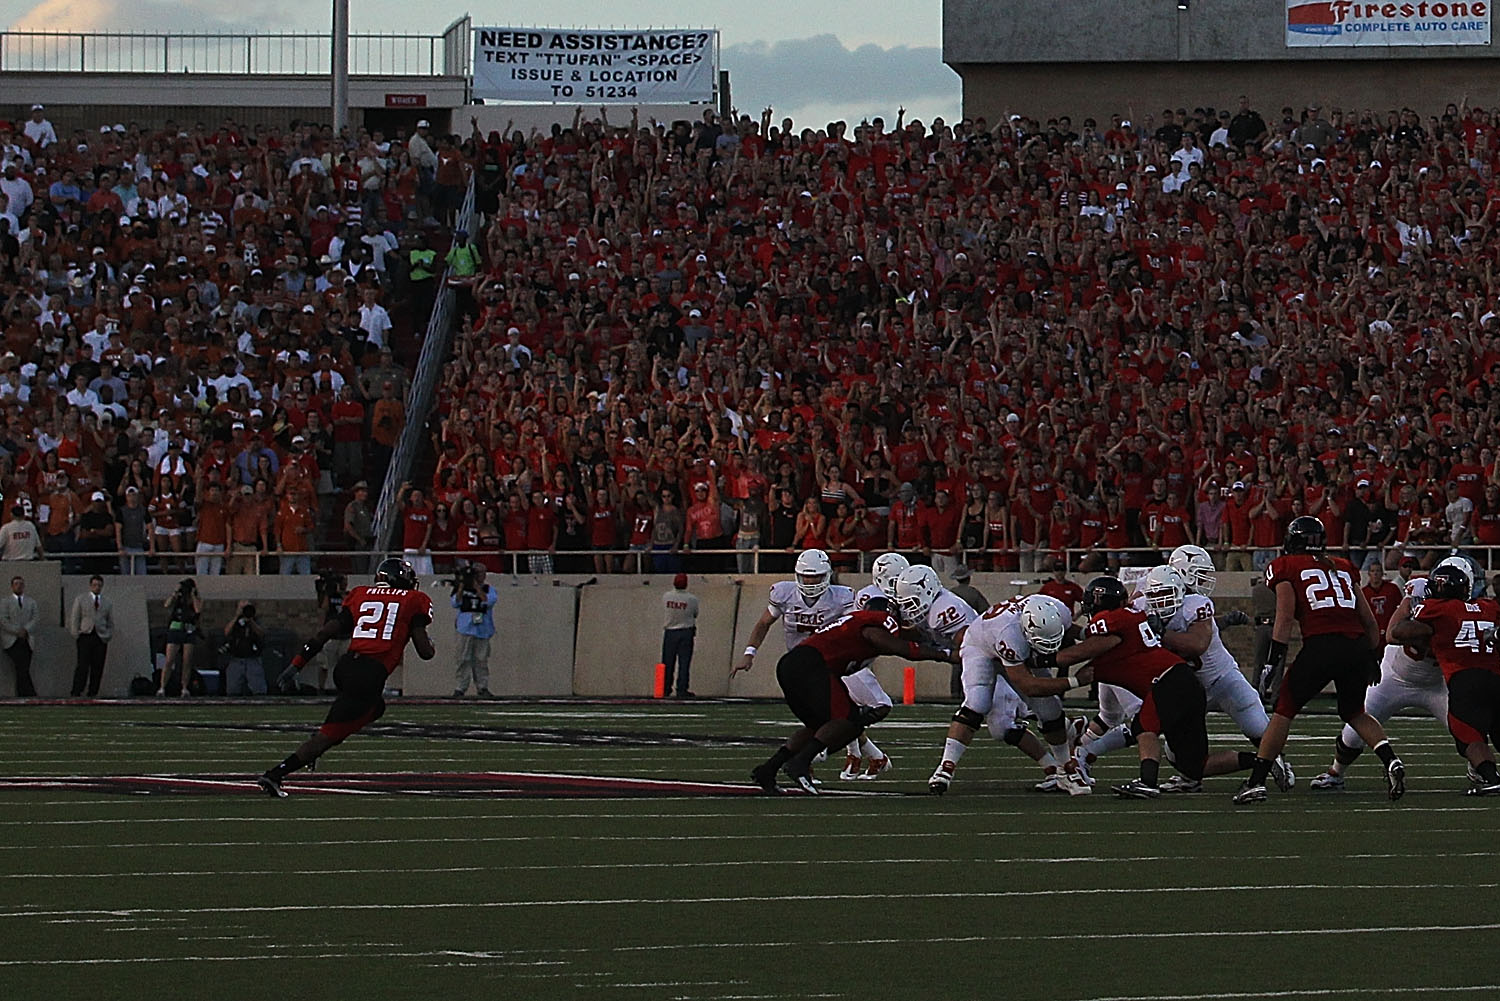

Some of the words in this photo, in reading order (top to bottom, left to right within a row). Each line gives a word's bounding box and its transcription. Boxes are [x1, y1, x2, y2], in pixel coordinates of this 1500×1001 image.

[1332, 0, 1486, 24] Firestone
[1345, 22, 1410, 32] COMPLETE
[1414, 22, 1447, 31] AUTO
[480, 31, 543, 48] NEED
[549, 33, 708, 50] ASSISTANCE?
[484, 51, 530, 64] TEXT
[536, 53, 621, 66] "TTUFAN"
[627, 53, 702, 66] <SPACE>
[511, 68, 563, 81] ISSUE
[571, 70, 582, 82] &
[590, 69, 677, 82] LOCATION
[551, 85, 573, 97] TO
[586, 86, 637, 98] 51234
[467, 527, 479, 546] 5
[366, 587, 409, 597] PHILLIPS
[1300, 568, 1357, 611] 20
[666, 600, 688, 610] STAFF
[1196, 603, 1215, 620] 63
[352, 601, 400, 640] 21
[794, 612, 825, 626] TEXAS
[938, 606, 960, 625] 72
[883, 615, 900, 634] 57
[1089, 618, 1108, 635] 93
